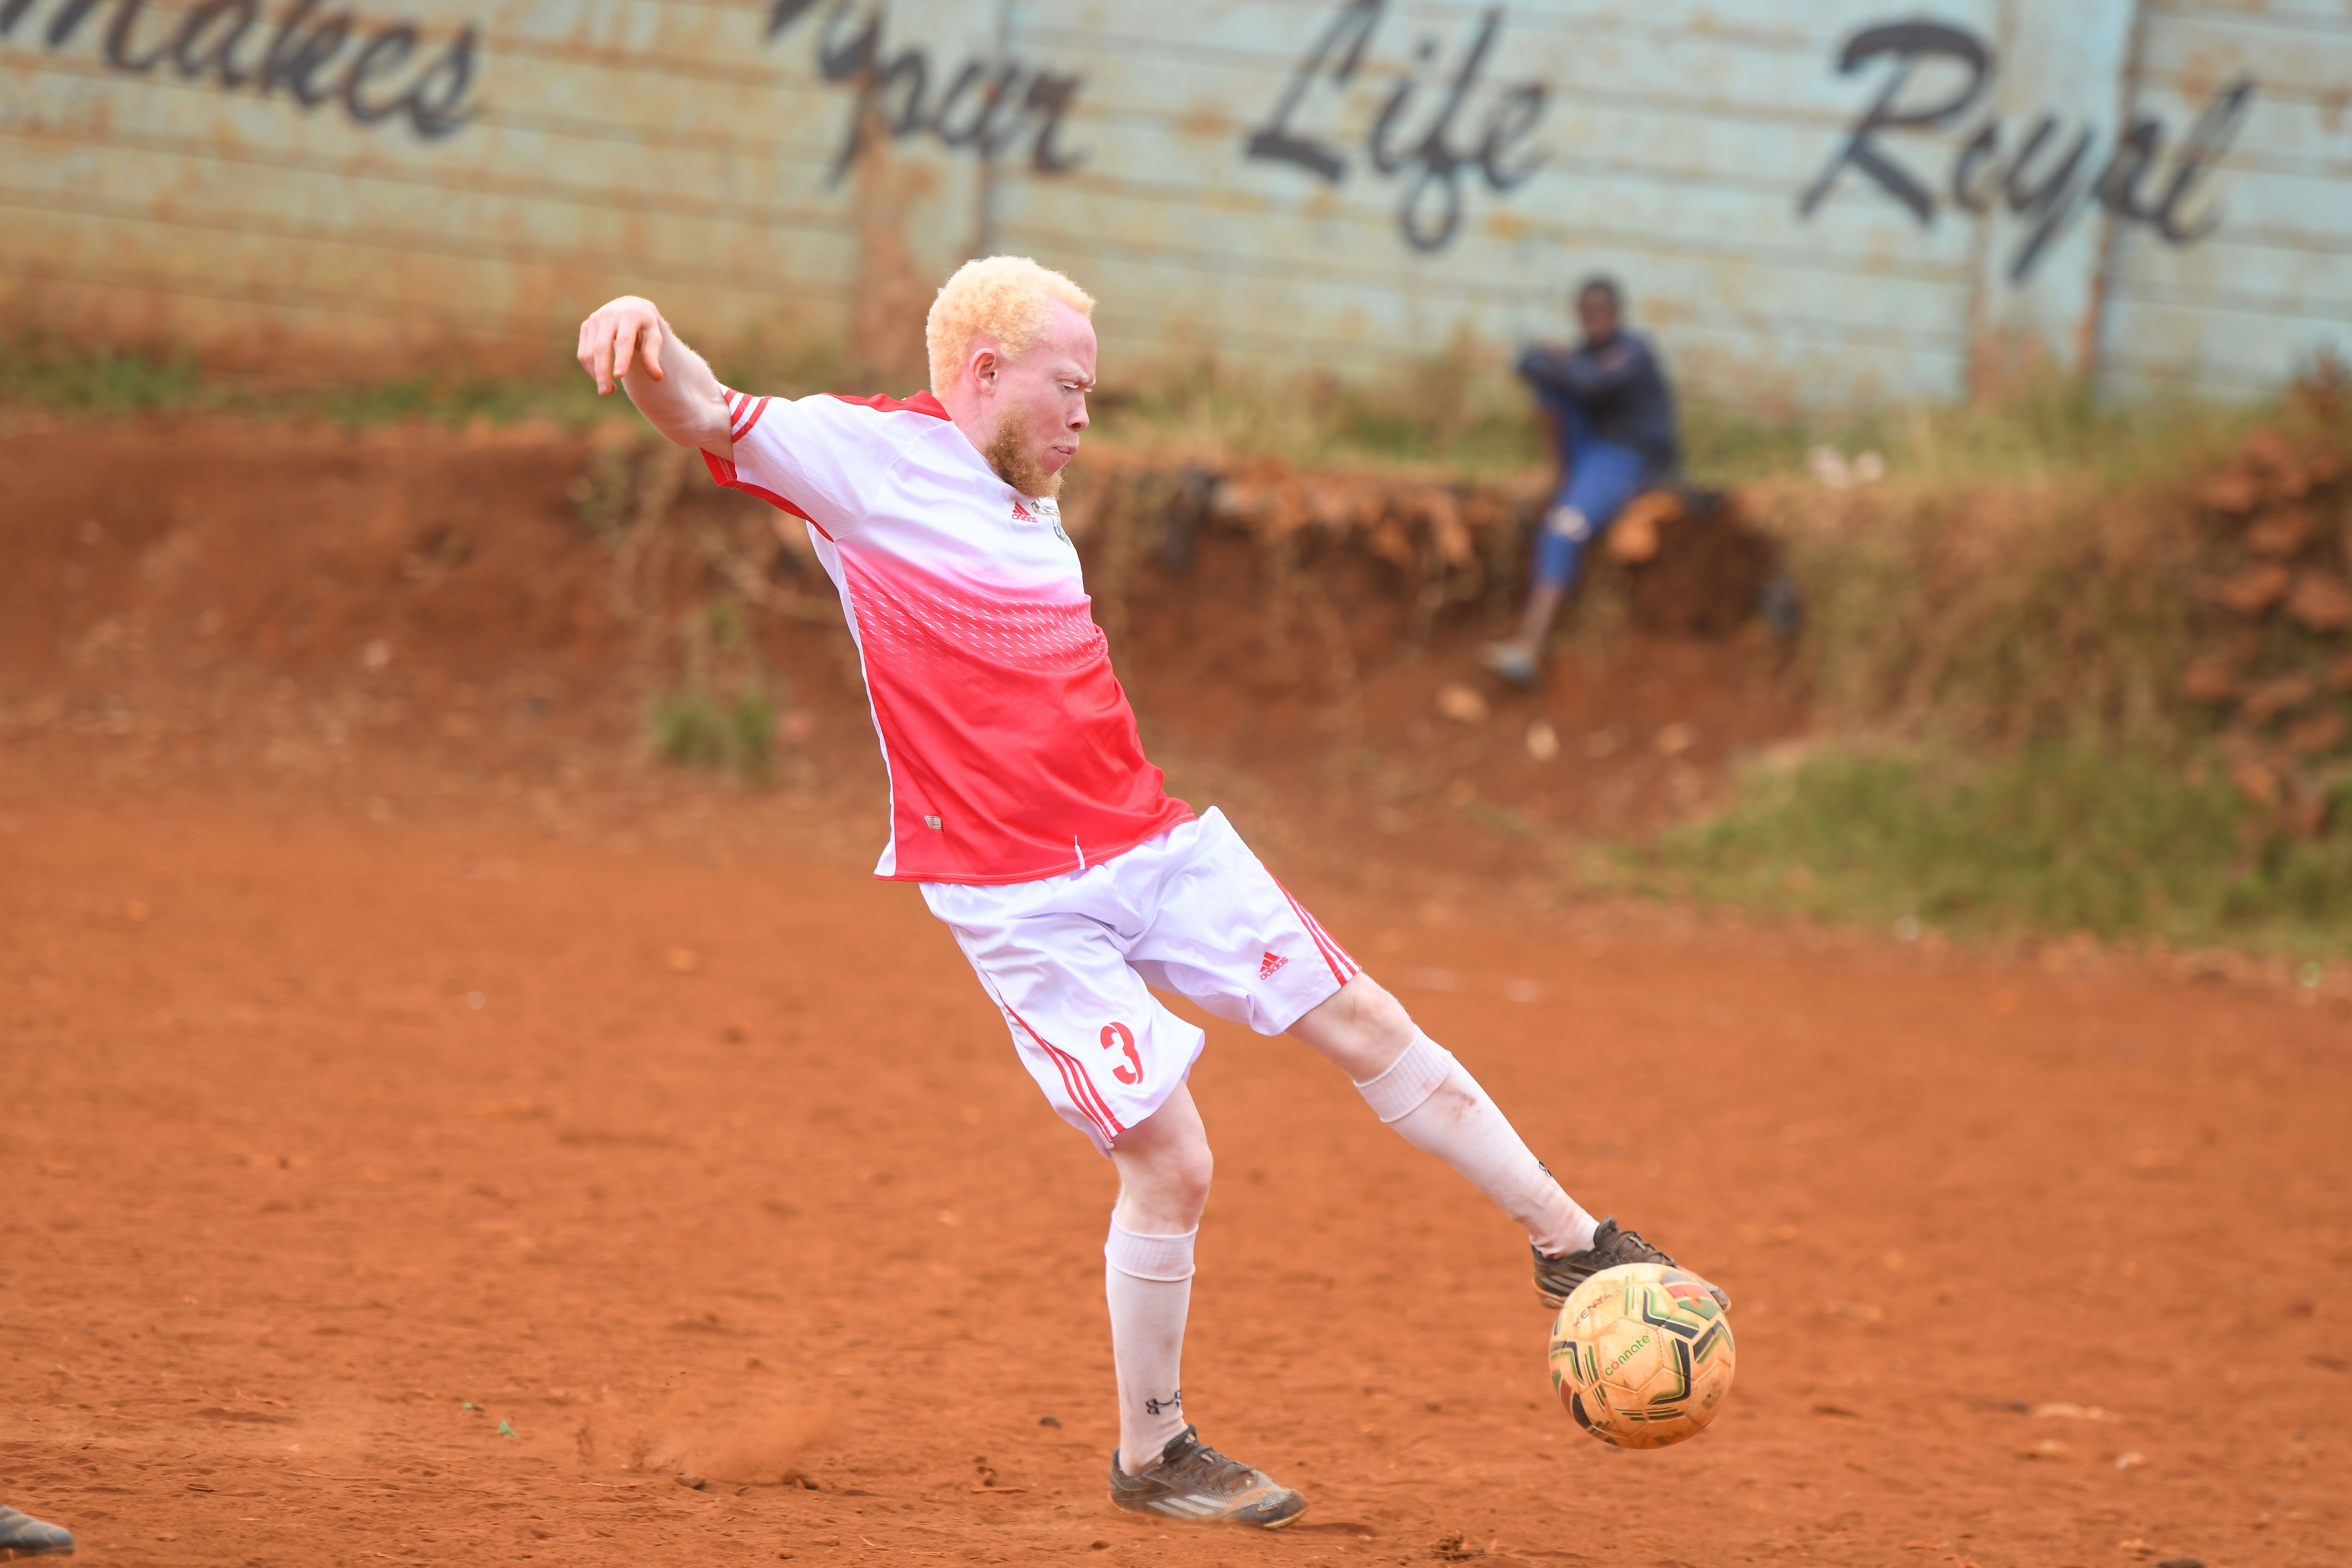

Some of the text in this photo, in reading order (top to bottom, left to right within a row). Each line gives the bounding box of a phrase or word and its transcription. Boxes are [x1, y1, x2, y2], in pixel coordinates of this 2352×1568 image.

[1244, 0, 1552, 253] Life
[1797, 21, 2255, 285] Royal
[1012, 514, 1038, 523] adidas
[1260, 957, 1288, 980] adidas
[1100, 1022, 1143, 1085] 3
[1605, 1335, 1650, 1376] connate
